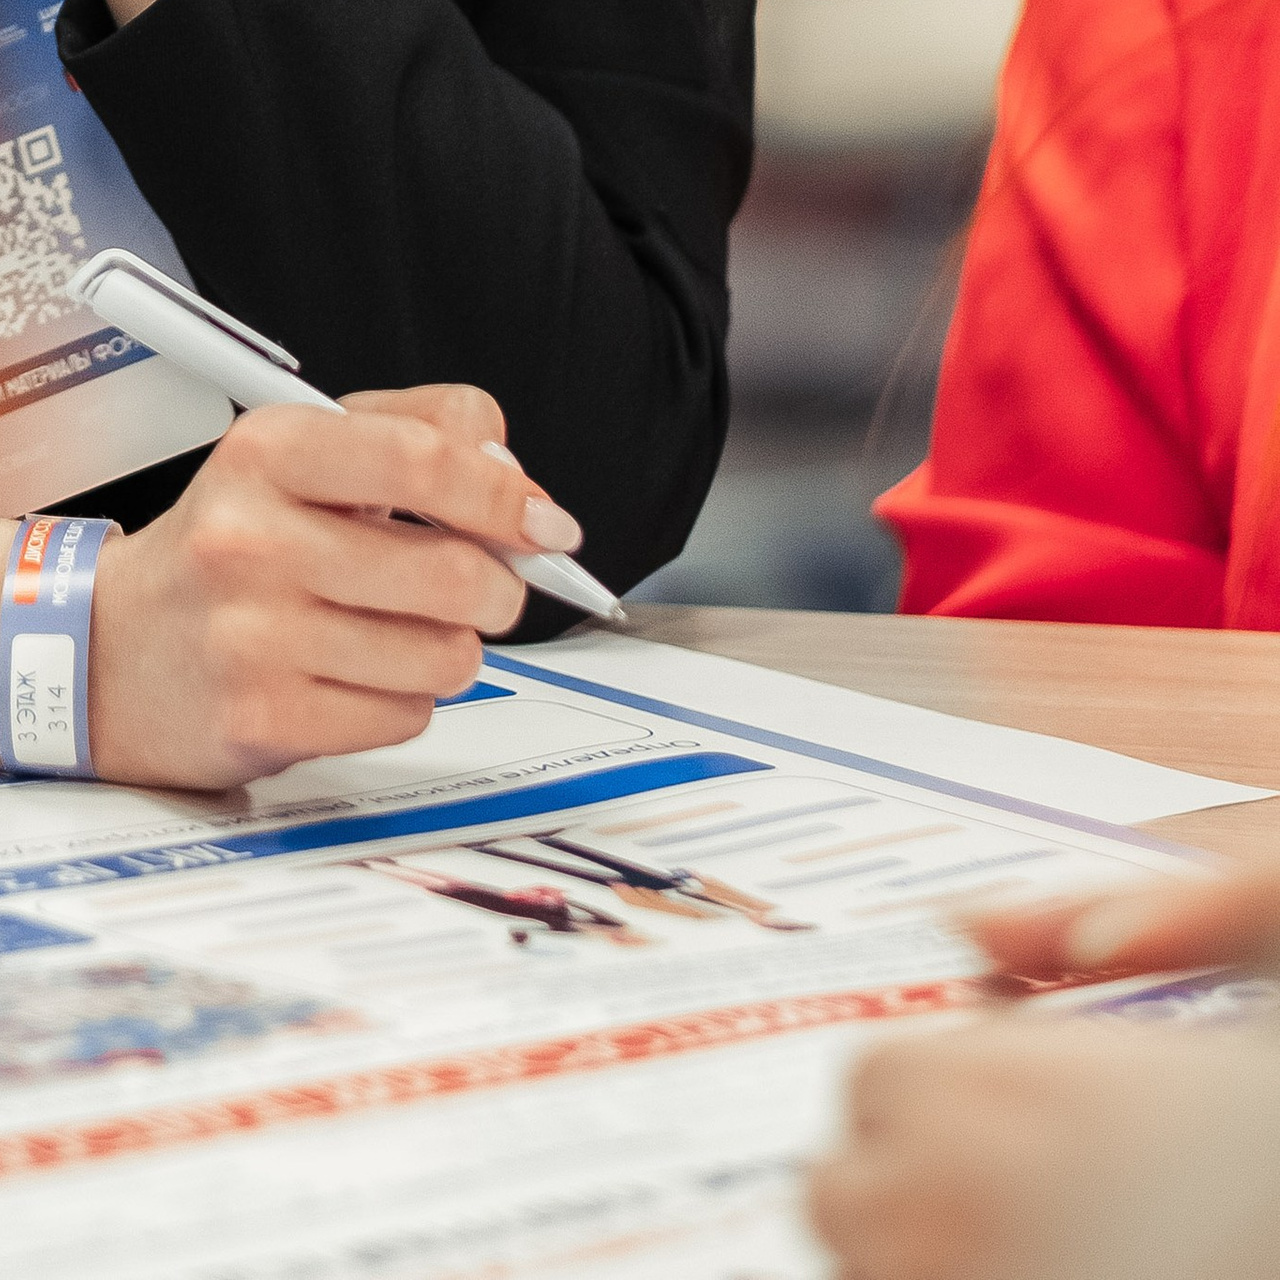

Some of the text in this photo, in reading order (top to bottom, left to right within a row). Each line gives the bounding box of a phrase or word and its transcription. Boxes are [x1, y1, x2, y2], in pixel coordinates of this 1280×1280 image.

[5, 349, 93, 397] МАТЕРИАЛЫ
[17, 670, 38, 742] 3 ЭТАЖ
[503, 738, 702, 780] Определите
[357, 776, 497, 807] вызовы,
